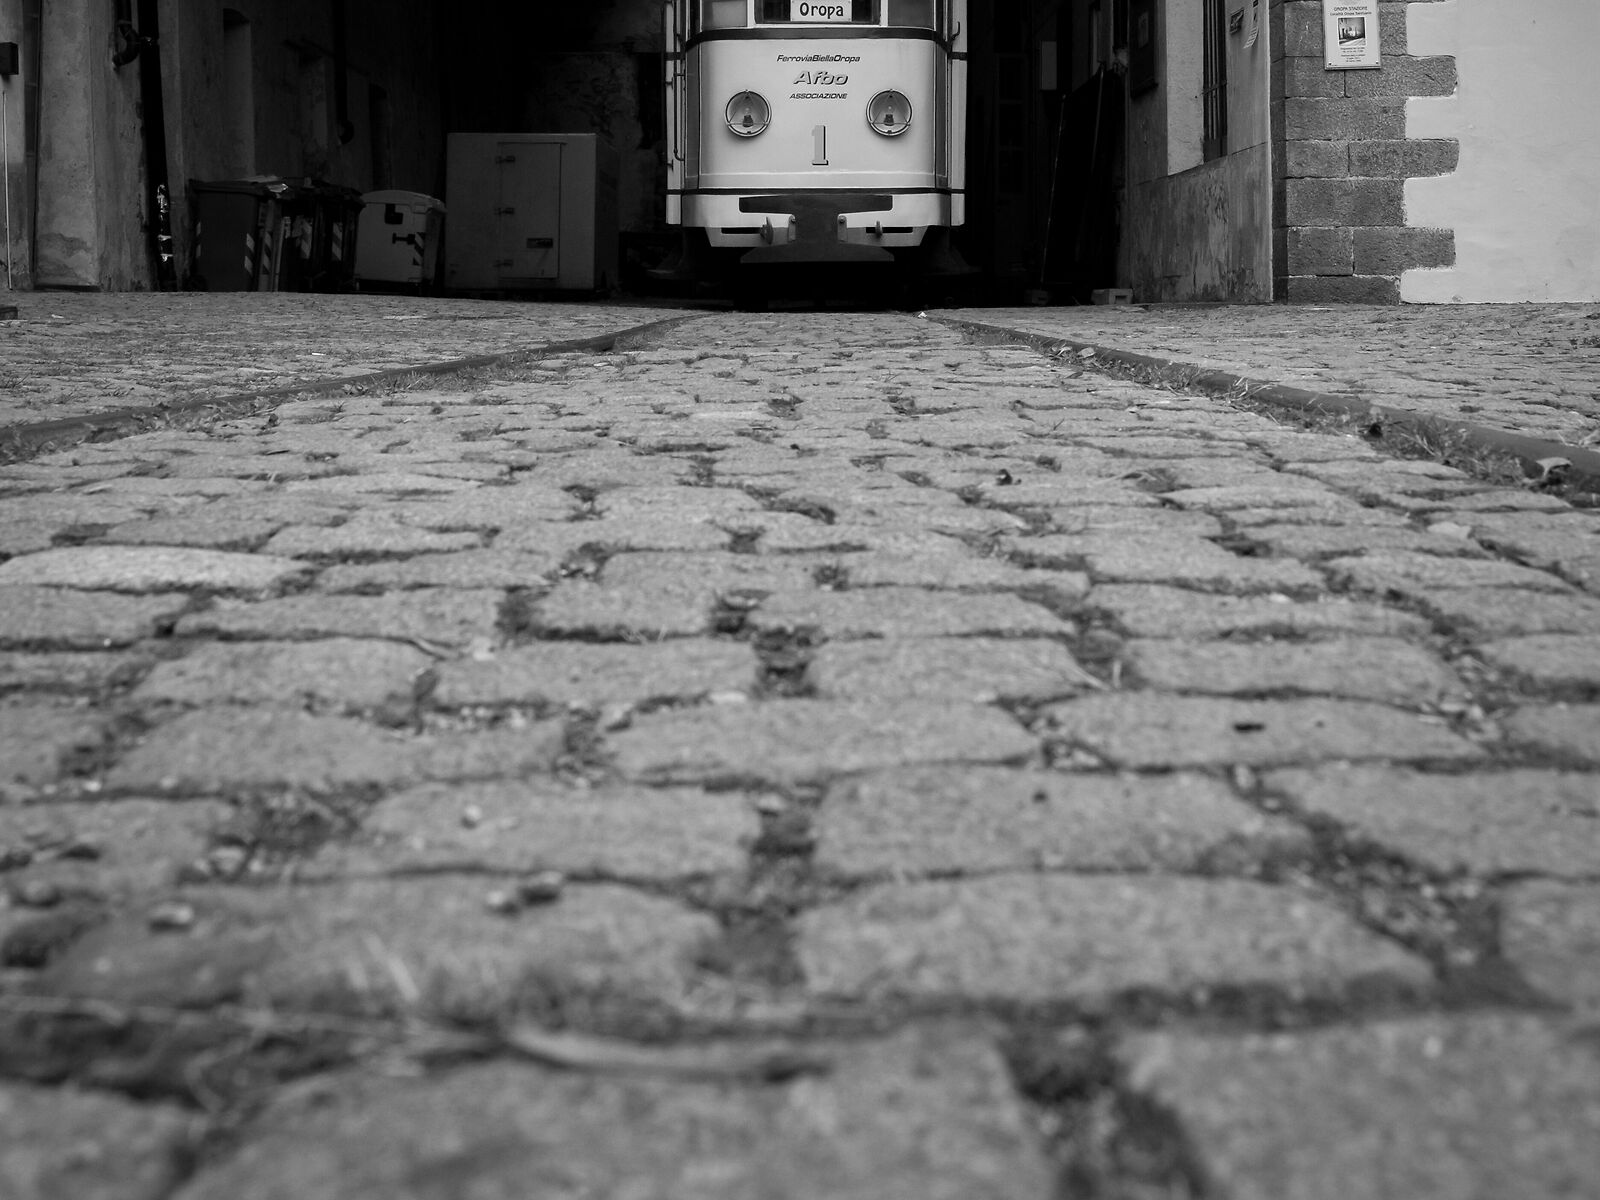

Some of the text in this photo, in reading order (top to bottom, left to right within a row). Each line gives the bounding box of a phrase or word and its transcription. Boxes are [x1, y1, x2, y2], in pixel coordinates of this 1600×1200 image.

[800, 2, 844, 19] Oropa
[776, 54, 860, 63] FerroviaBiellaOropa
[812, 125, 828, 166] 1
